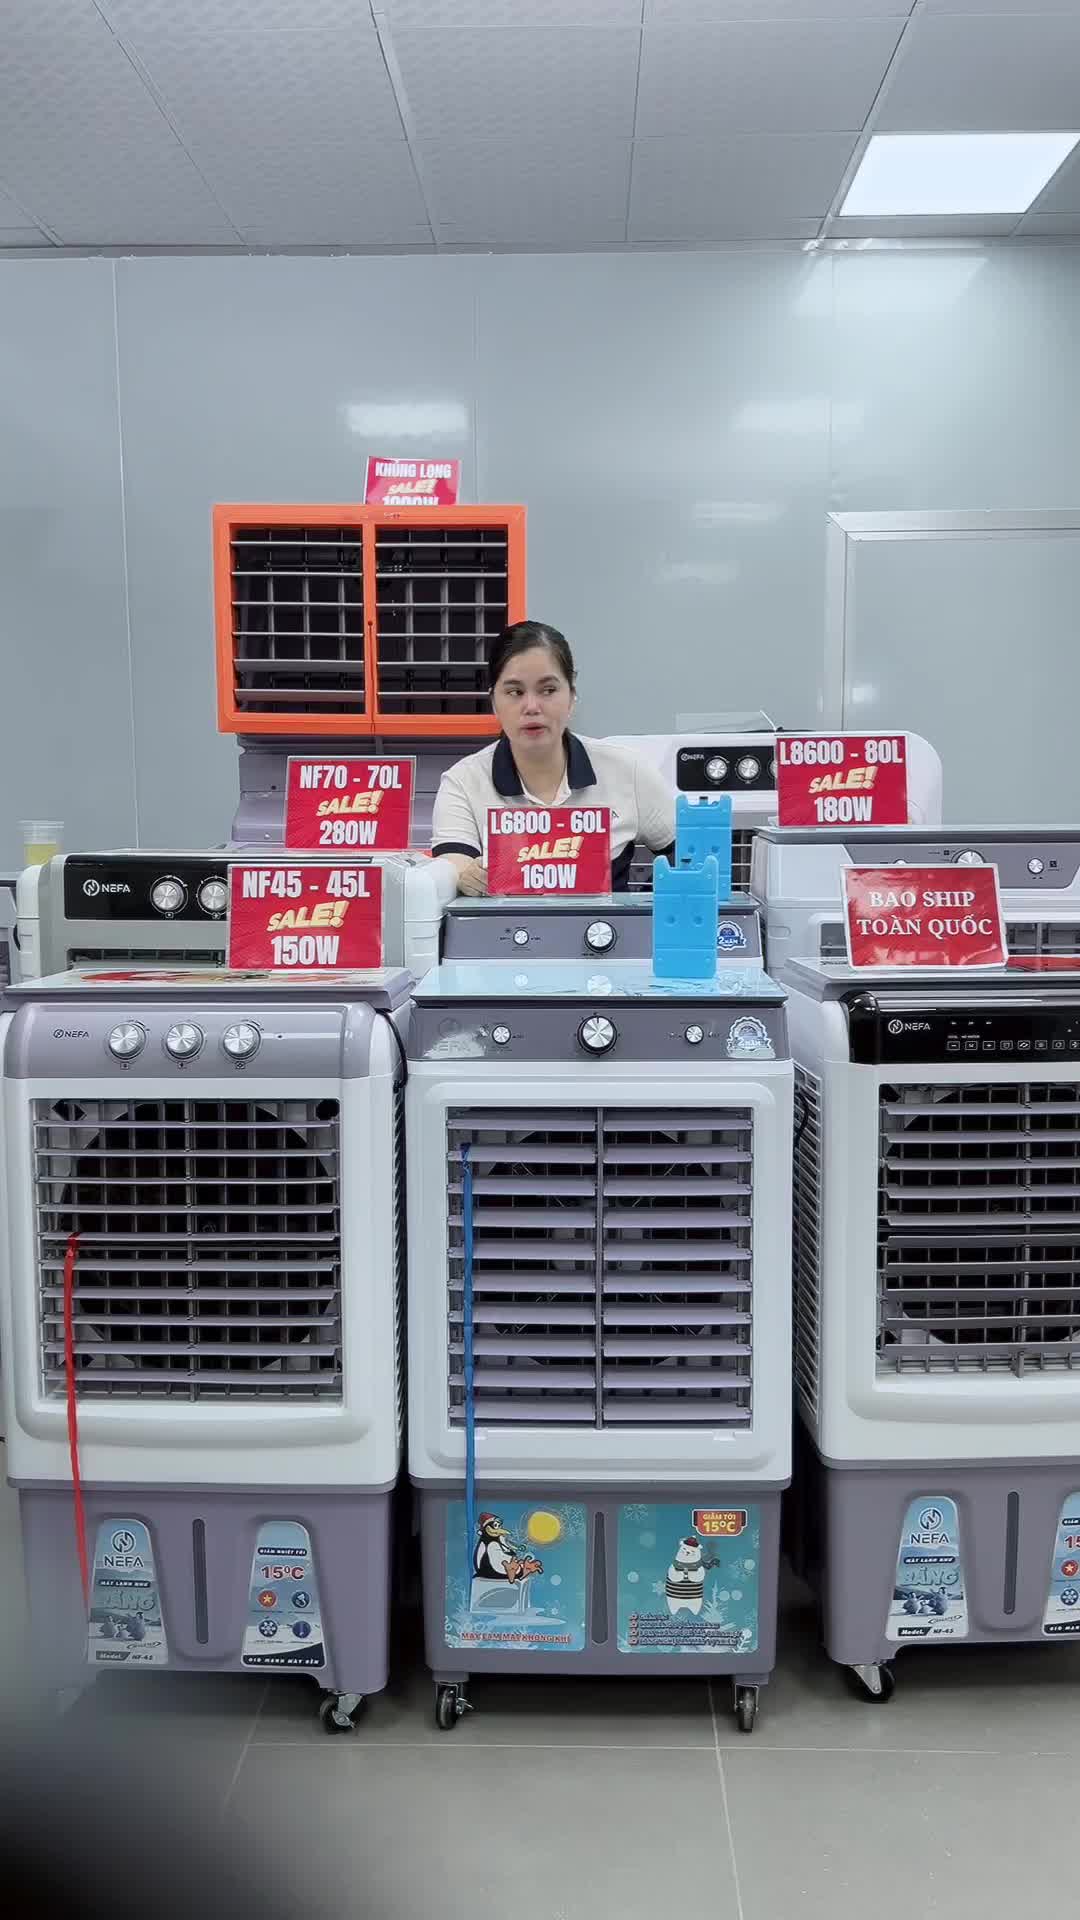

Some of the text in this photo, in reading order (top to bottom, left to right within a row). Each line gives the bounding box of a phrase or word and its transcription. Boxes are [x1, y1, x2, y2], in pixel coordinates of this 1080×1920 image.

[420, 463, 452, 479] LONG
[780, 740, 845, 766] L8600
[864, 739, 904, 764] 80L
[300, 765, 348, 789] NF70
[367, 765, 403, 789] 70L
[808, 765, 878, 794] SALE!
[315, 790, 385, 817] SALE!
[814, 796, 873, 823] 180W
[319, 820, 378, 846] 280W
[490, 810, 552, 835] L6800
[570, 810, 606, 834] 60L
[516, 835, 584, 863] SALE!
[101, 884, 131, 893] NEFA
[242, 870, 302, 899] NF45
[326, 870, 371, 899] 45L
[520, 864, 578, 890] 160W
[869, 890, 976, 908] BAO SHIP
[266, 900, 350, 933] SALE!
[856, 913, 993, 940] TOÀN QUỐC
[270, 935, 340, 966] 150W
[64, 1030, 90, 1038] NEFA
[904, 1022, 931, 1031] NEFA
[910, 1533, 950, 1544] NEFA
[104, 1555, 144, 1568] NEFA
